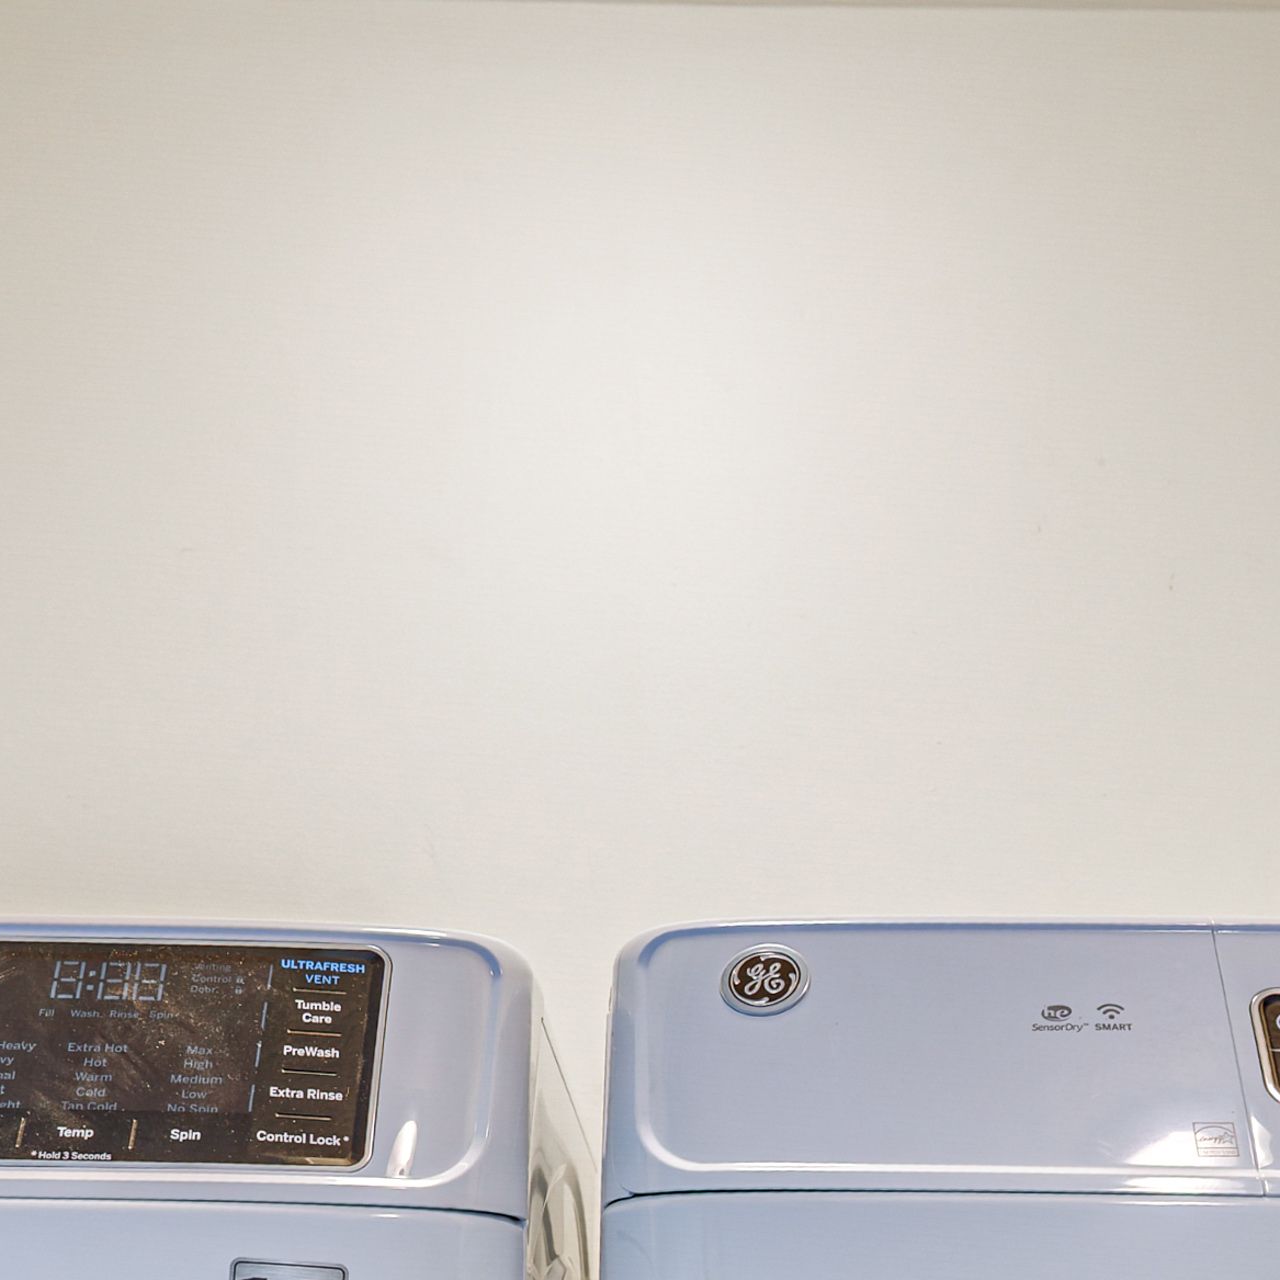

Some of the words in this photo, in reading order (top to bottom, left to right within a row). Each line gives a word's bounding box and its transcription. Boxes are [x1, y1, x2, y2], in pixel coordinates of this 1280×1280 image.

[281, 959, 366, 974] ULTRAFRESH
[305, 975, 341, 986] VENT
[295, 1000, 342, 1013] Tumble
[39, 1008, 55, 1017] Fill
[71, 1010, 100, 1018] Wash
[110, 1010, 139, 1019] Rinse
[149, 1011, 174, 1020] Spin
[302, 1013, 333, 1025] Care
[1095, 1023, 1133, 1031] SMART
[67, 1043, 101, 1052] Extra
[105, 1043, 129, 1053] Hot
[187, 1046, 213, 1055] Max
[283, 1046, 340, 1059] PreWash
[84, 1058, 108, 1068] Hot
[184, 1059, 213, 1070] High
[76, 1072, 113, 1082] Warm
[170, 1074, 223, 1085] Medium
[76, 1087, 106, 1097] Cold
[182, 1089, 207, 1100] Low
[270, 1088, 303, 1100] Extra
[307, 1089, 343, 1101] Rinse
[87, 1101, 118, 1111] Cold
[168, 1104, 185, 1113] No
[57, 1127, 94, 1141] Temp
[170, 1129, 202, 1143] Spin
[257, 1131, 308, 1144] Control
[310, 1133, 341, 1146] Lock
[38, 1151, 61, 1160] Hold
[62, 1151, 69, 1160] 3
[71, 1152, 112, 1161] Seconds
